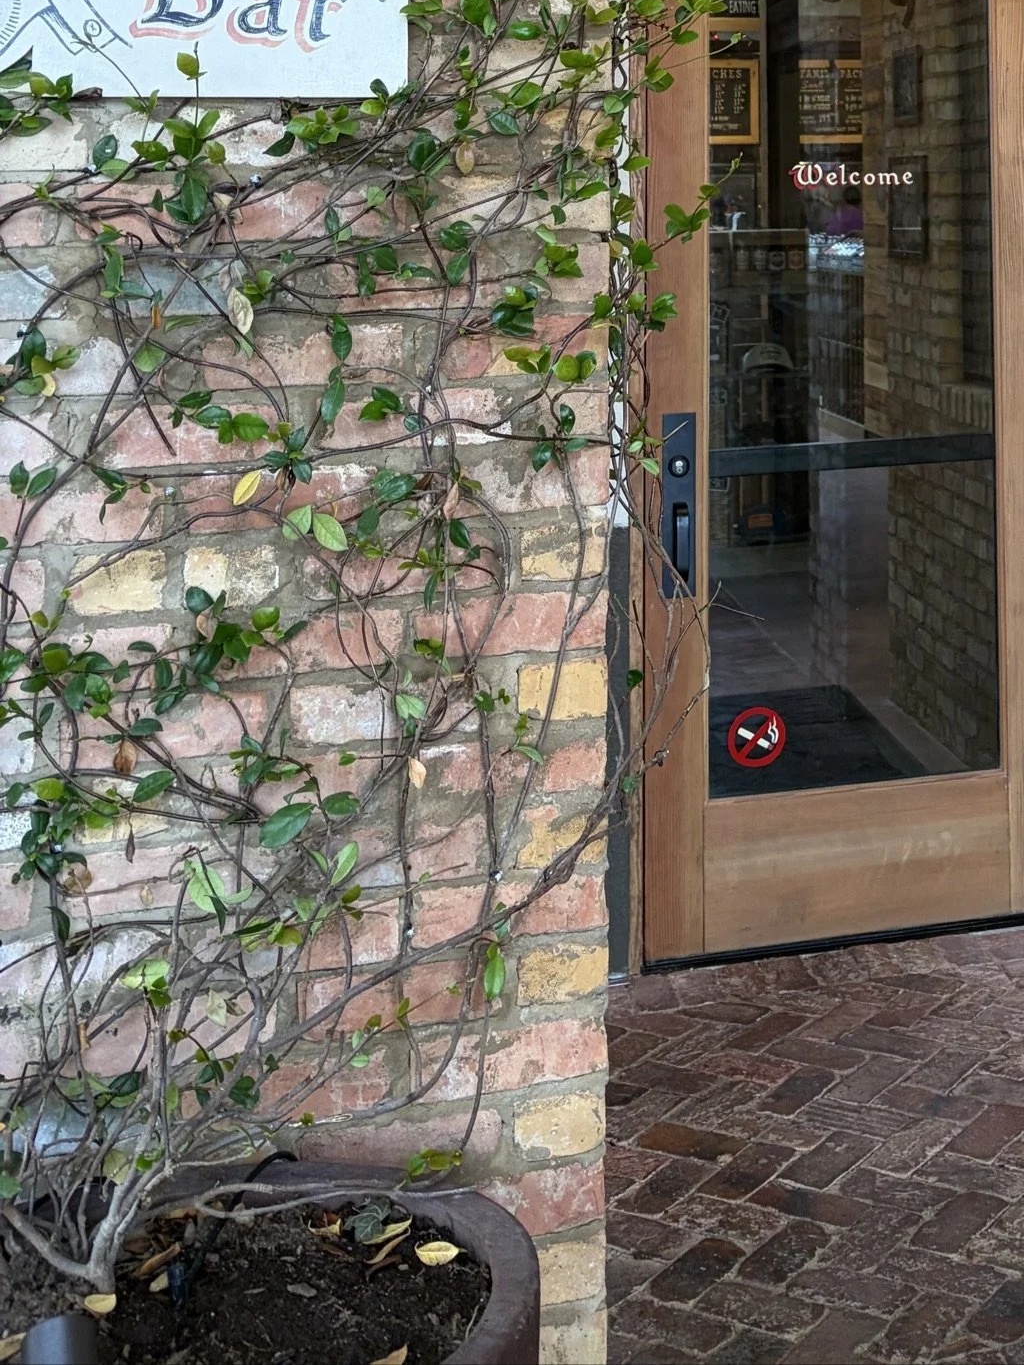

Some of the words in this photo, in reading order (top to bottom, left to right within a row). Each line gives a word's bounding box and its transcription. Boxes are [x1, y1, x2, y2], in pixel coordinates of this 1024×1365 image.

[729, 0, 757, 14] EATING
[800, 69, 832, 79] FAMIL
[789, 161, 914, 190] Welcome
